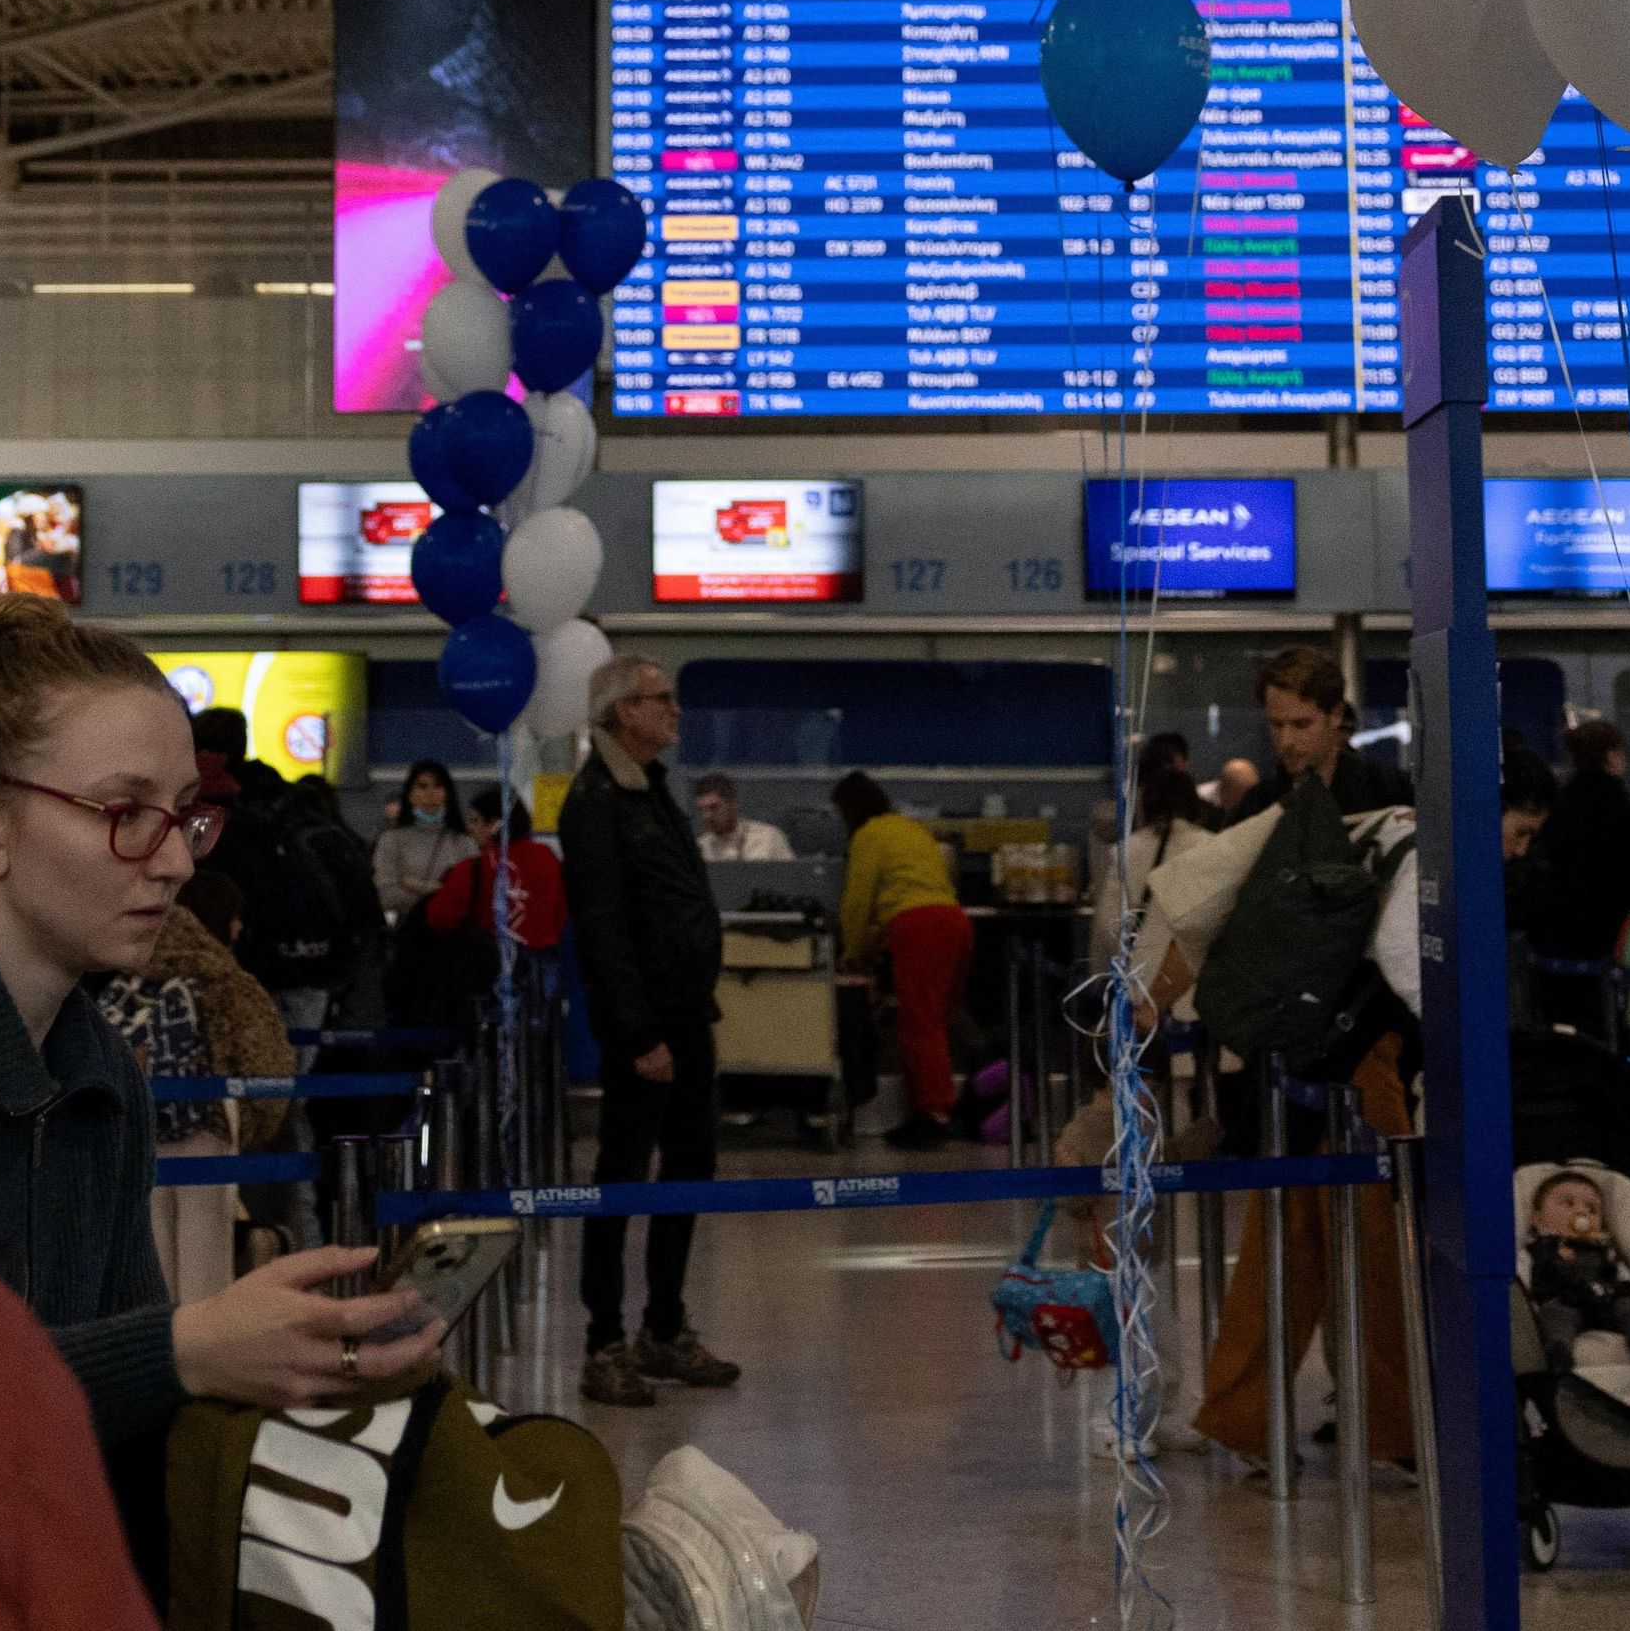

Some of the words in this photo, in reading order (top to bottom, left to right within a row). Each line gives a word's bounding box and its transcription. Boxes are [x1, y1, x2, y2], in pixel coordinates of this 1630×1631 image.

[1129, 509, 1229, 525] AEGEAN
[110, 563, 165, 594] 129
[533, 1185, 603, 1202] ATHENS
[834, 1176, 902, 1195] ATHENS
